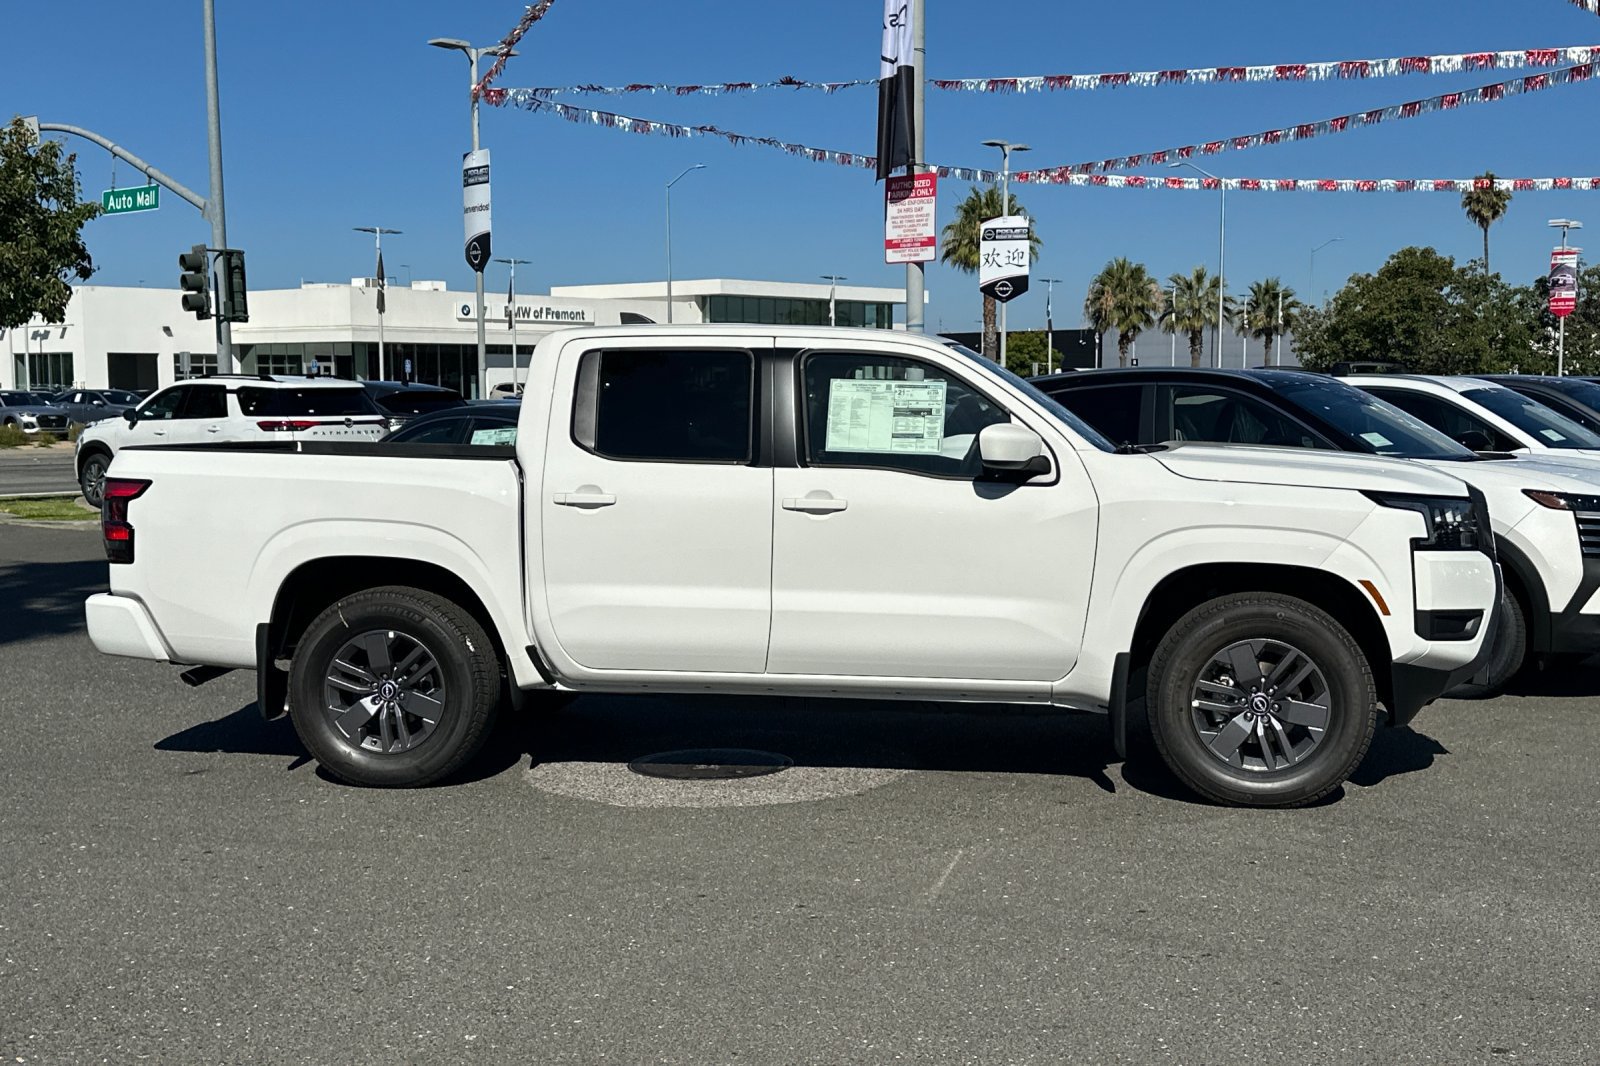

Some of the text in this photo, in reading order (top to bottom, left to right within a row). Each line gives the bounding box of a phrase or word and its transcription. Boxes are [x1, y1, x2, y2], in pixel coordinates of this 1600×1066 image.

[108, 190, 155, 210] Auto Mall
[917, 188, 933, 197] ONLY
[983, 248, 1027, 267] 欢迎
[533, 307, 543, 319] of
[545, 307, 585, 320] Fremont
